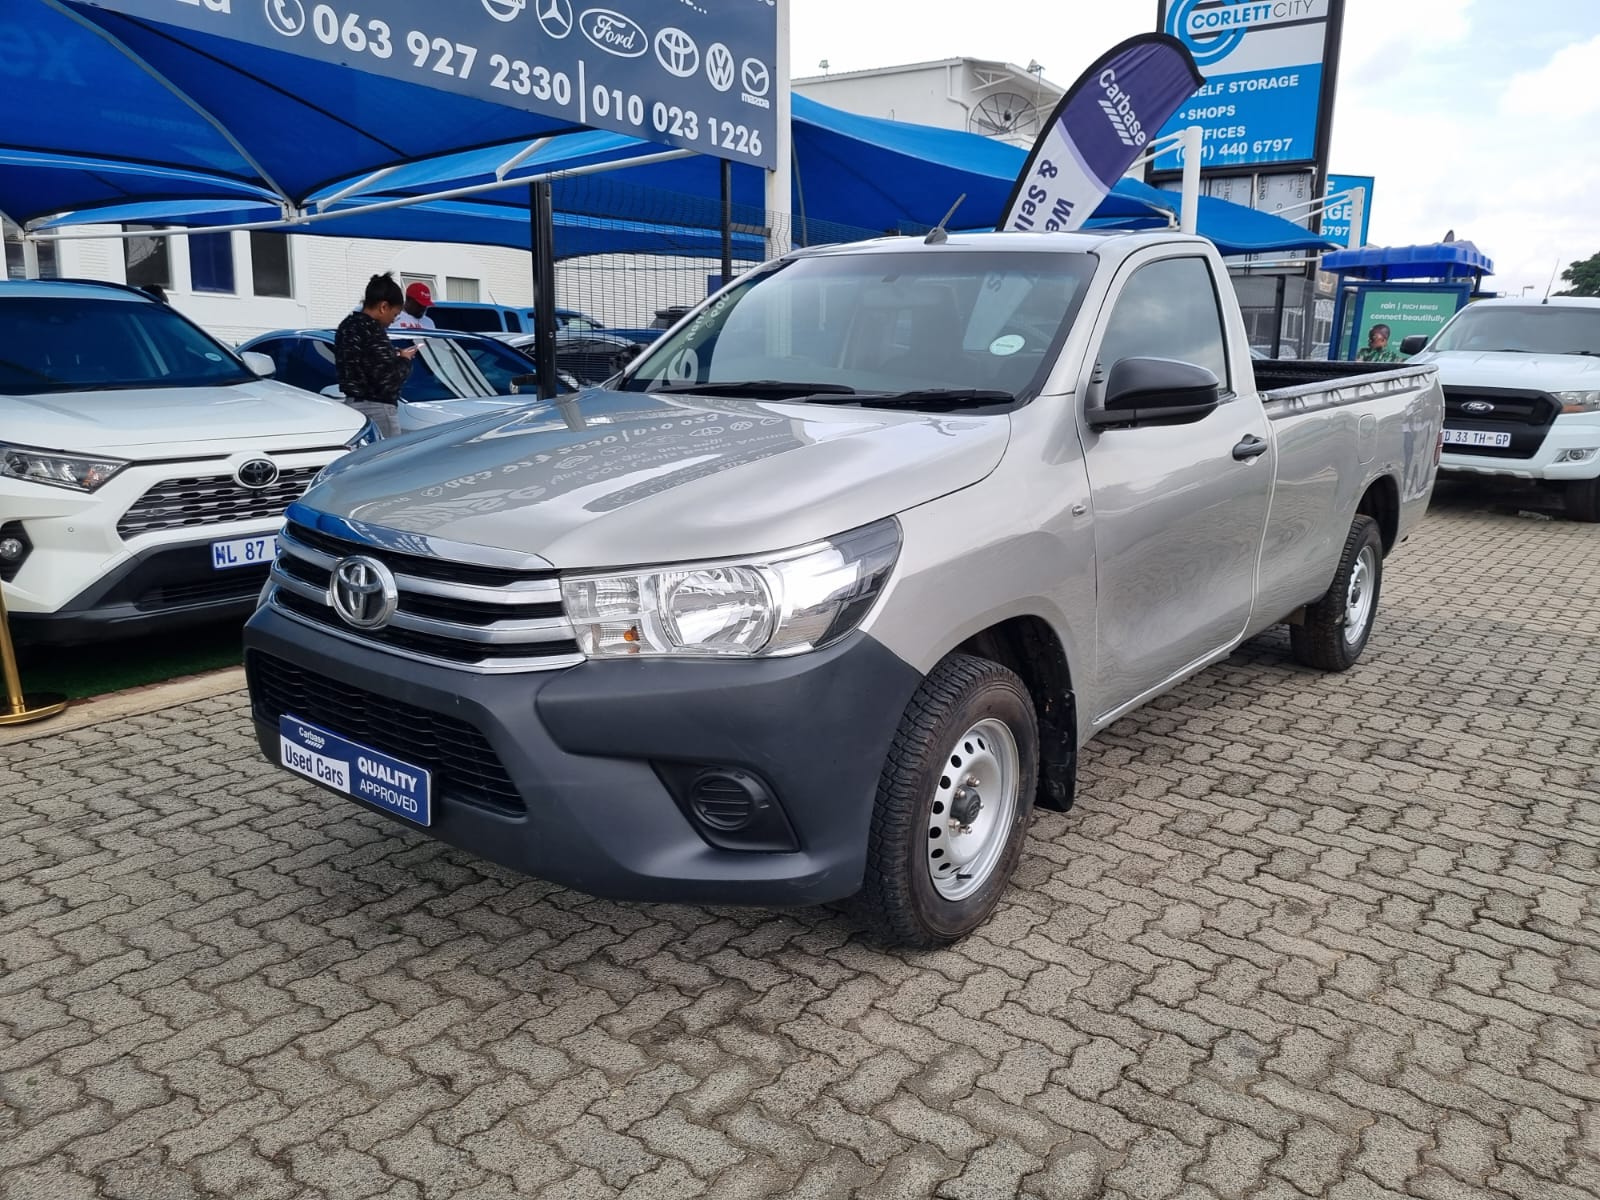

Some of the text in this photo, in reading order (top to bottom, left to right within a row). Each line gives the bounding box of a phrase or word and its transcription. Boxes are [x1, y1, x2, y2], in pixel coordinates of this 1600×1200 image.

[592, 15, 636, 49] Ford
[313, 4, 763, 157] 063 927 2330 010 023 1226
[1228, 74, 1299, 94] STORAGE
[1099, 69, 1147, 146] Carbase
[1187, 104, 1236, 120] SHOPS
[1218, 142, 1248, 156] 440
[1252, 137, 1293, 154] 6797
[1037, 159, 1058, 179] &
[1045, 198, 1074, 231] We
[1402, 314, 1445, 323] beautifully
[1455, 431, 1468, 442] 33
[1474, 432, 1486, 444] TH
[1495, 434, 1509, 445] GP
[245, 540, 265, 561] 87
[298, 726, 325, 745] Carbase
[285, 743, 344, 787] Used Cars
[357, 756, 417, 793] QUALITY
[359, 779, 418, 813] APPROVED
